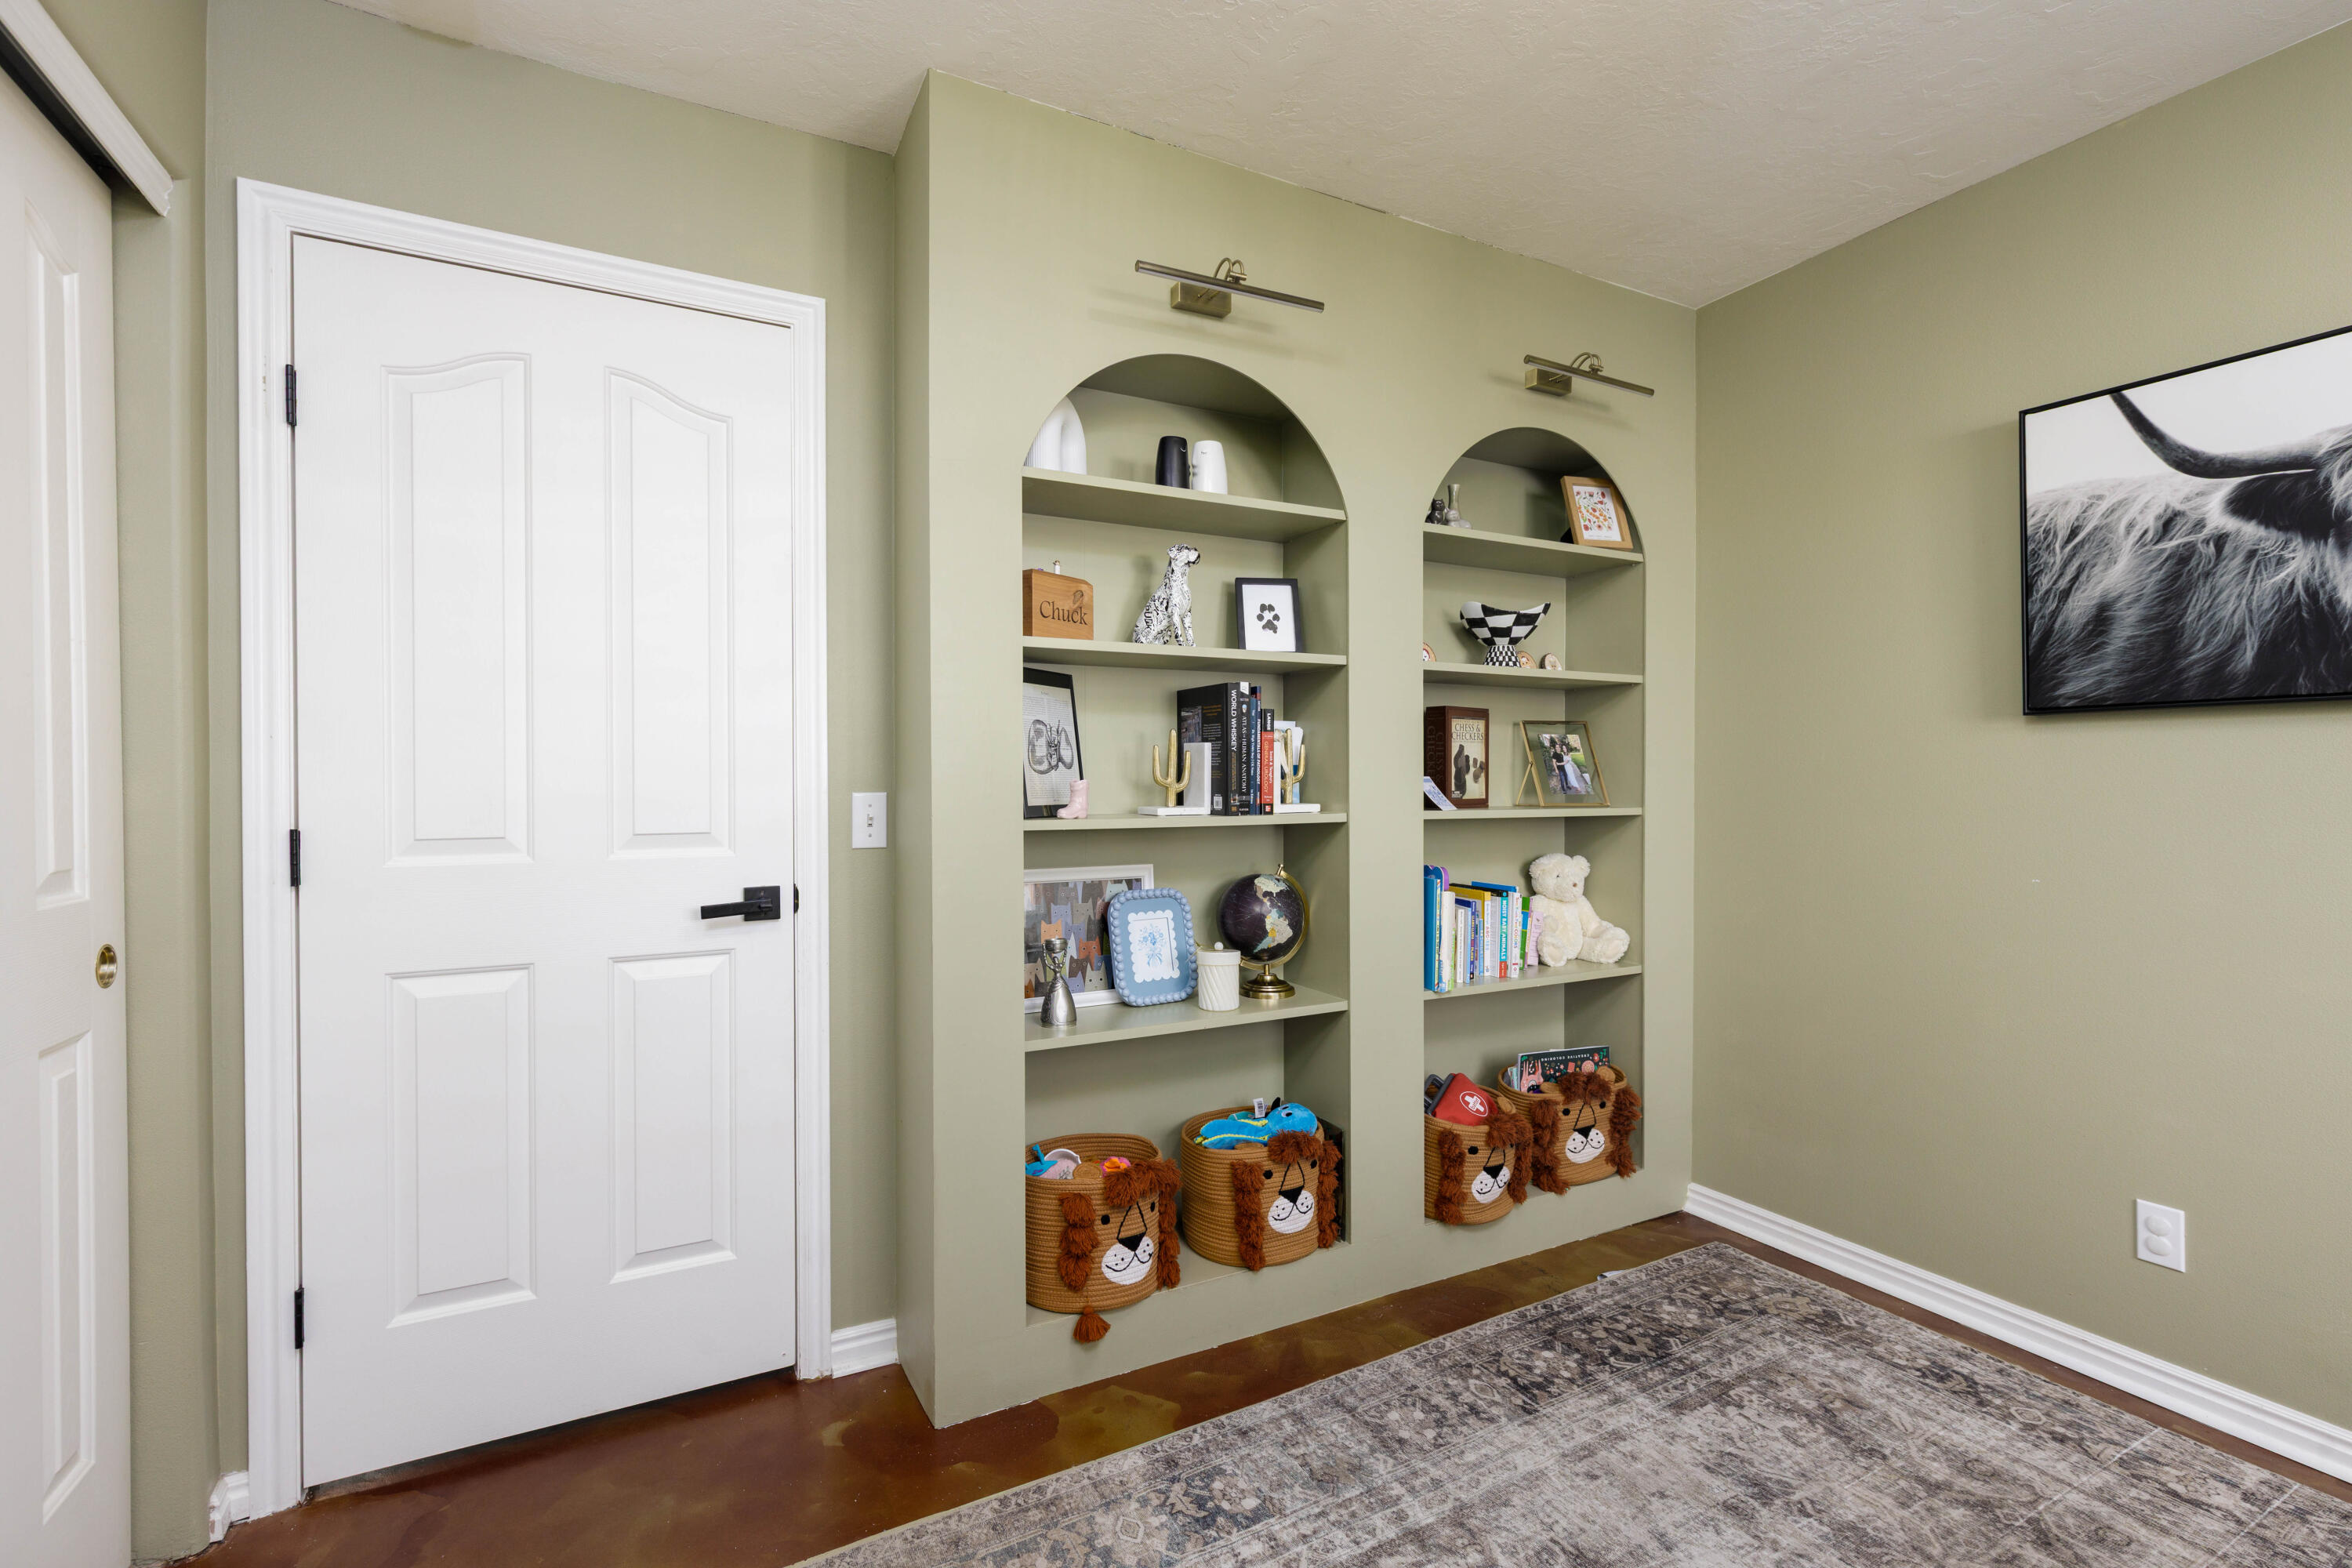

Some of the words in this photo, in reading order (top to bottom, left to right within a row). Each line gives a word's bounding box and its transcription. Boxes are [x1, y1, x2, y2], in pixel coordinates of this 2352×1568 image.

[1040, 601, 1088, 626] Chuck
[1454, 723, 1475, 732] CHESS
[1451, 731, 1484, 741] CHECKERS
